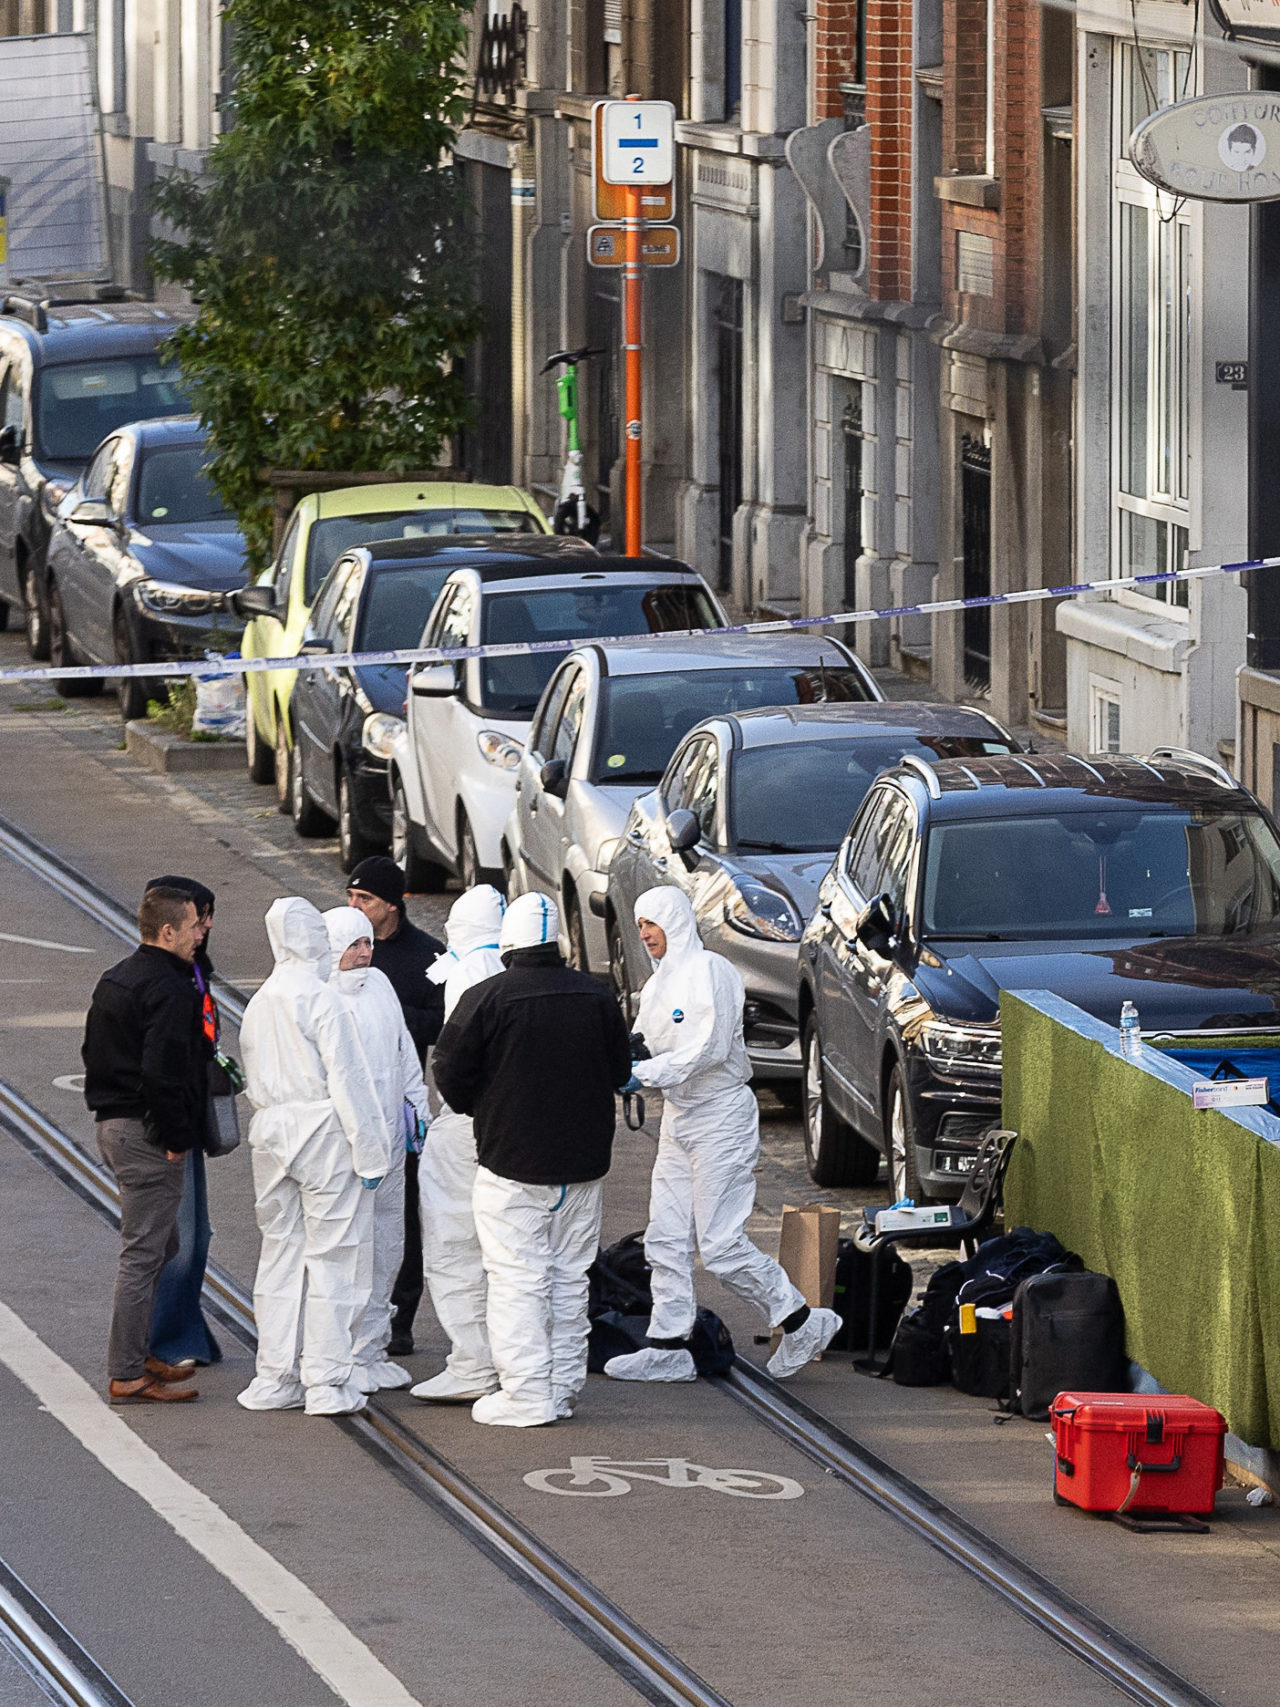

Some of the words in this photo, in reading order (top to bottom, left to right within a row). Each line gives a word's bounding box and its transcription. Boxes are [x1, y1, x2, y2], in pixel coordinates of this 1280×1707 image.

[633, 113, 641, 129] 1
[633, 157, 644, 173] 2
[1223, 365, 1245, 382] 23
